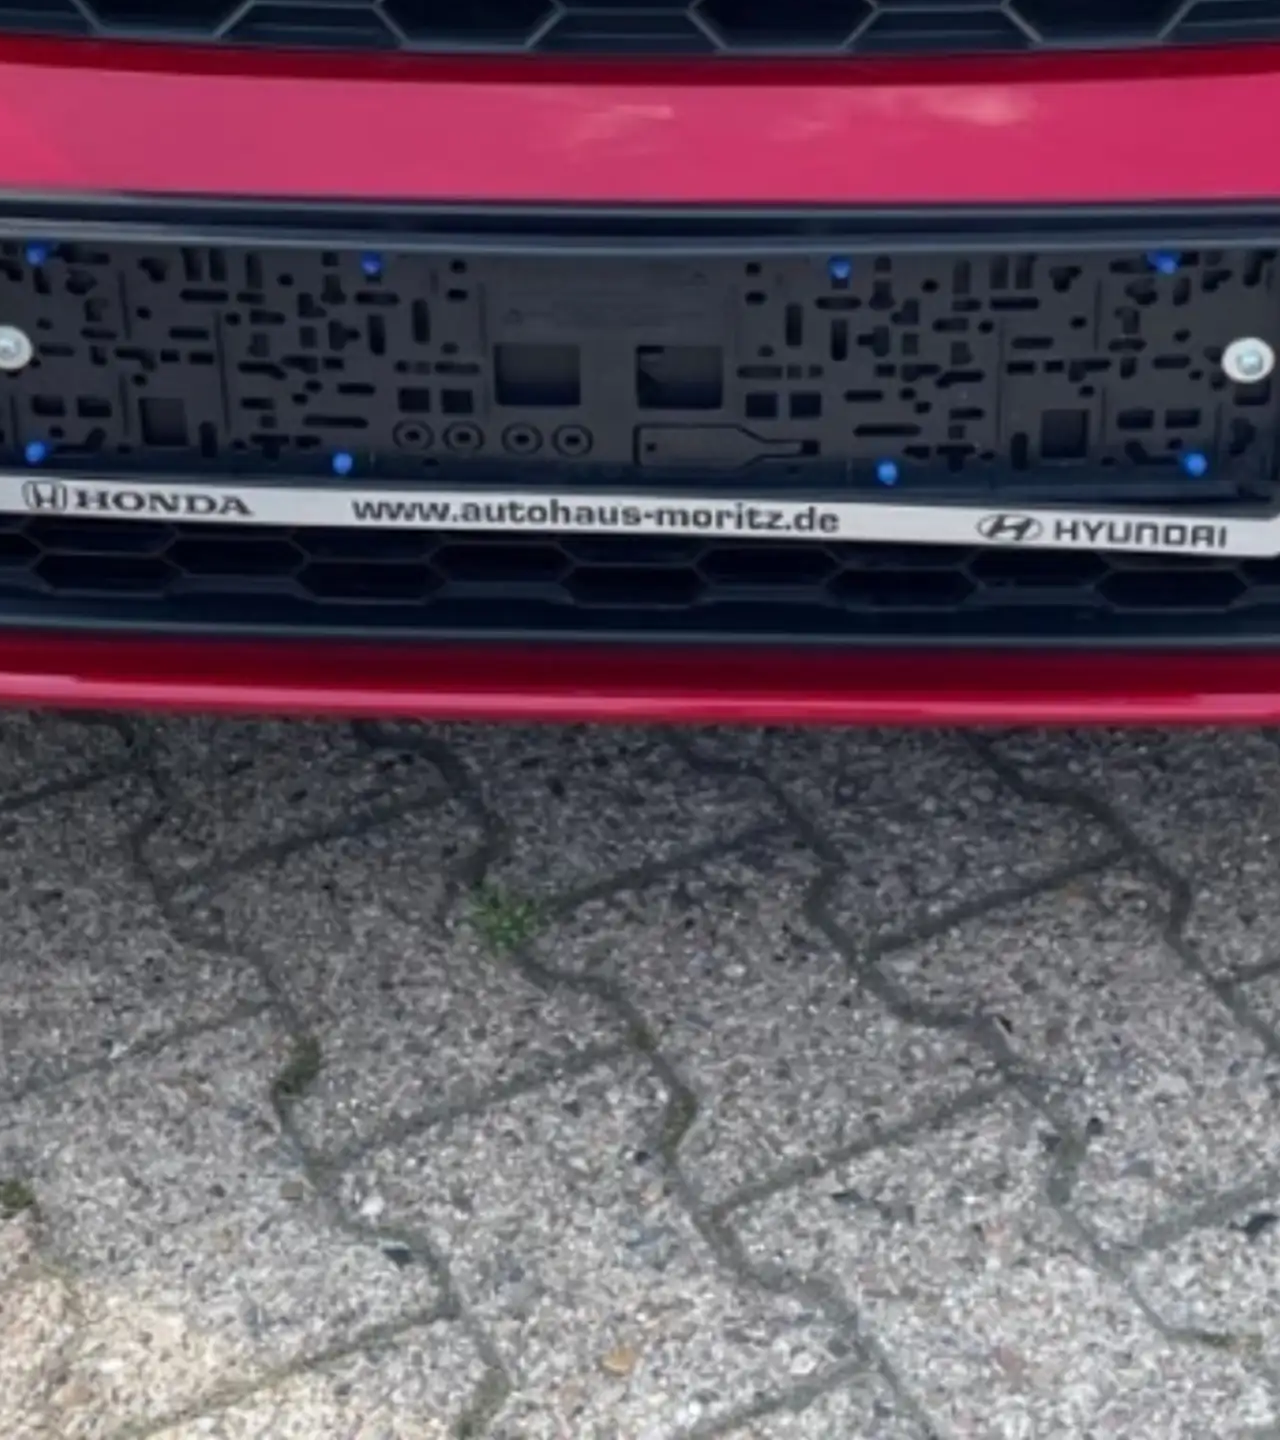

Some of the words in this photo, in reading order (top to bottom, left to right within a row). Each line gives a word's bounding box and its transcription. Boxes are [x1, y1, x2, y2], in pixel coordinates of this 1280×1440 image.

[76, 489, 252, 516] HONDA
[352, 498, 840, 534] www.autohaus-moritz.de
[1055, 520, 1227, 548] HYUNDAI
